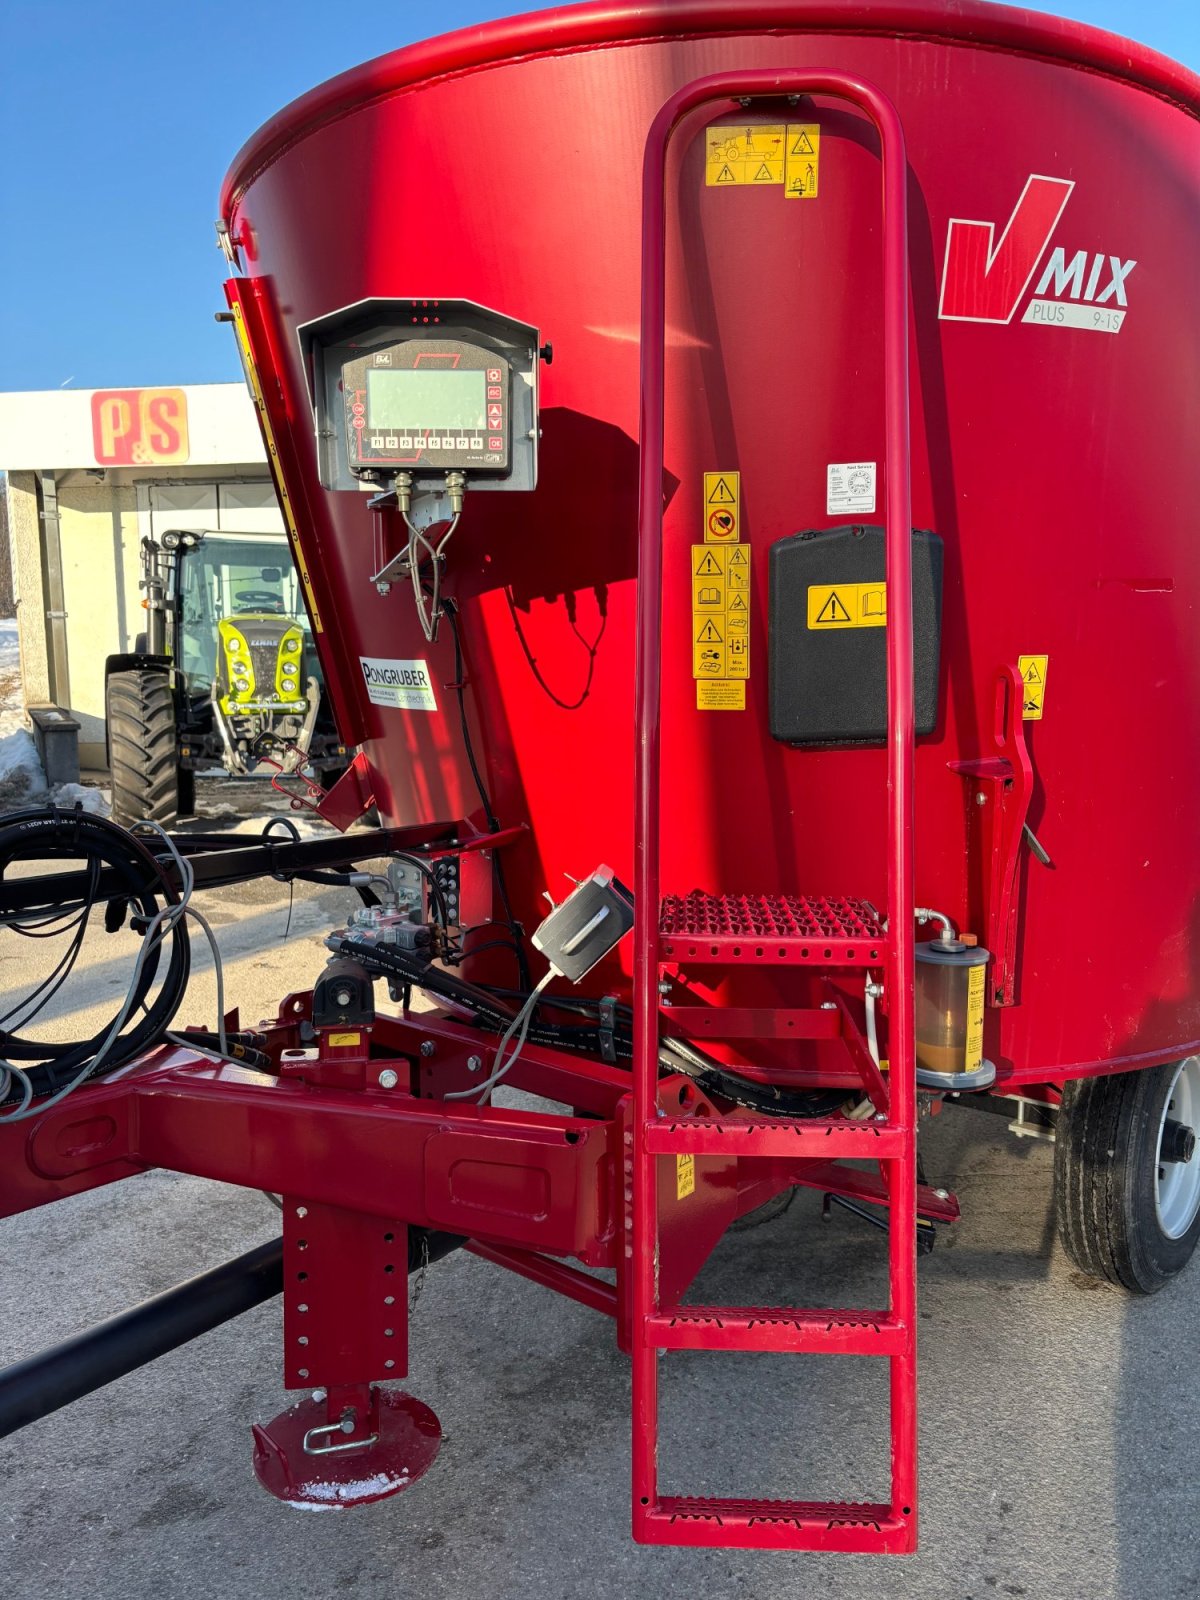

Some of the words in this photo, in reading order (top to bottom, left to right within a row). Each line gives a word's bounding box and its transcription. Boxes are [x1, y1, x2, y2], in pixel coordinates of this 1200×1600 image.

[1034, 247, 1137, 306] MIX
[234, 306, 241, 319] 0
[1032, 303, 1065, 322] PLUS
[1093, 311, 1120, 330] 9-1S
[246, 351, 253, 365] 1
[258, 398, 265, 411] 2
[100, 397, 180, 464] P&S
[270, 443, 277, 456] 3
[282, 486, 288, 499] 4
[291, 529, 299, 542] 5
[303, 572, 310, 584] 6
[313, 612, 320, 625] 7
[362, 662, 428, 686] PONGRUBER
